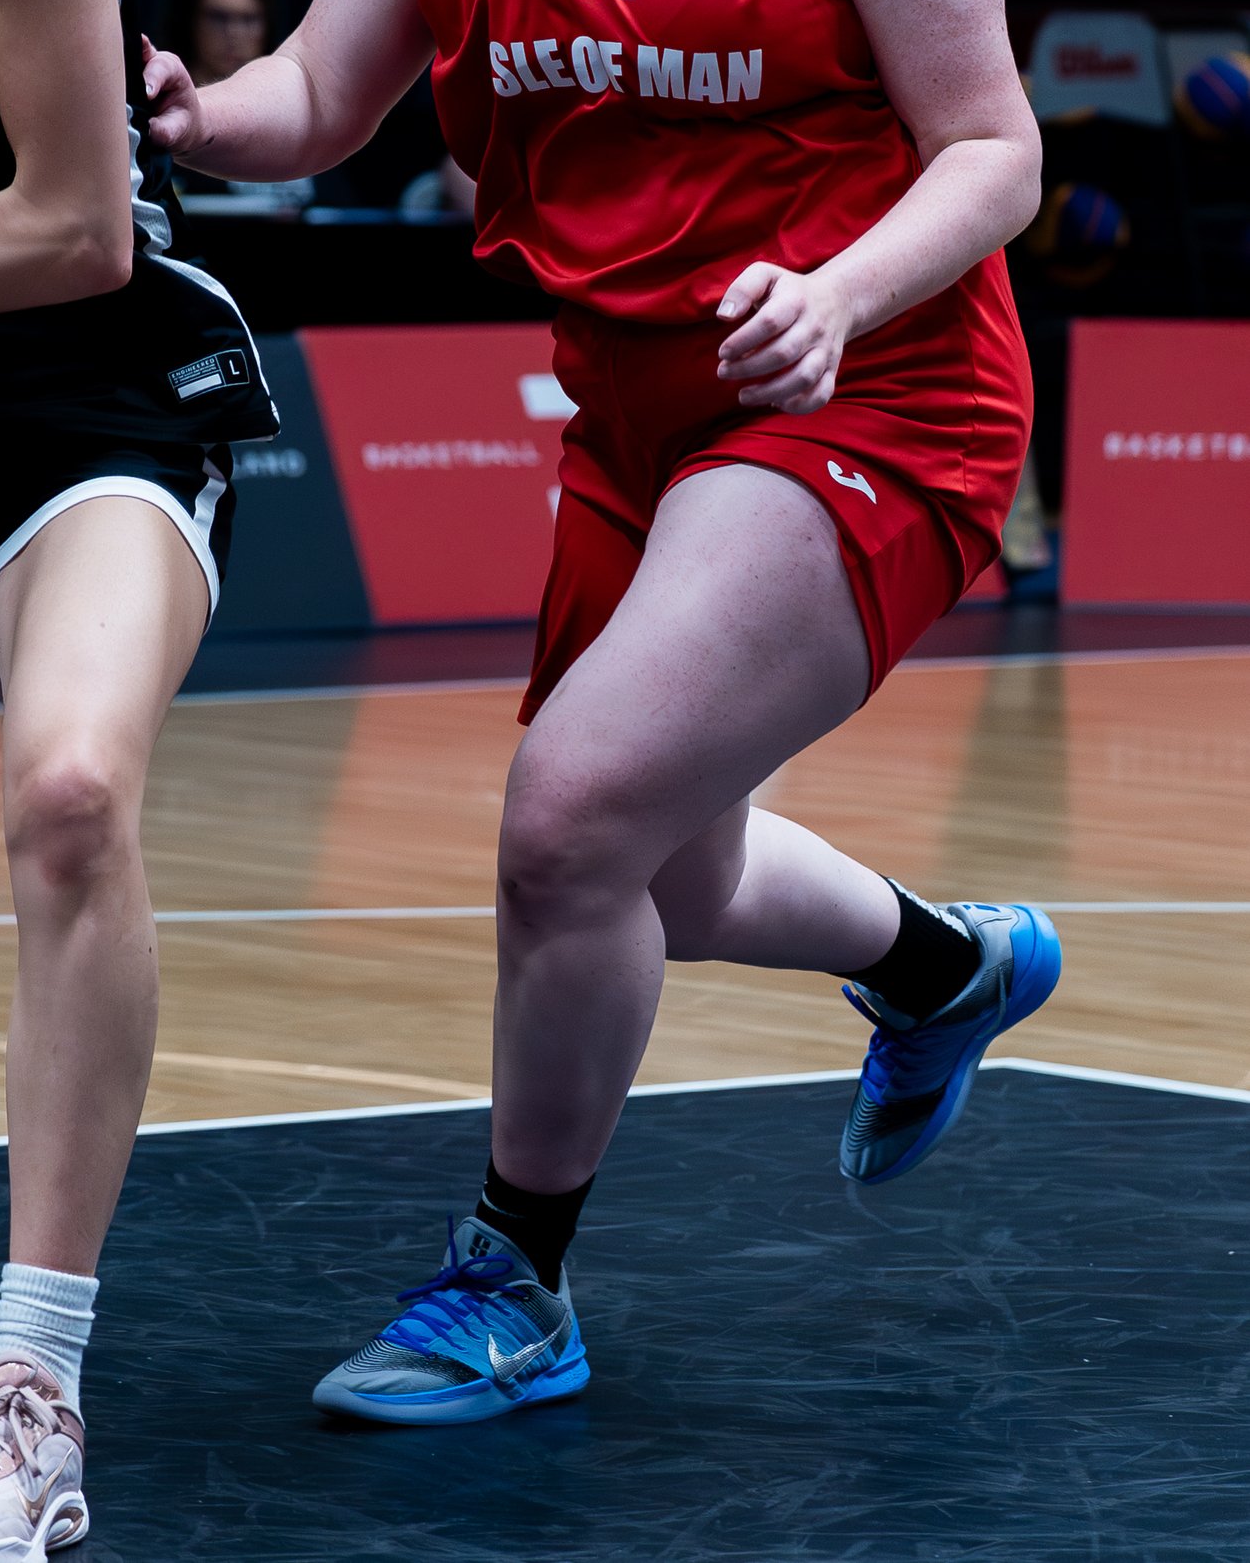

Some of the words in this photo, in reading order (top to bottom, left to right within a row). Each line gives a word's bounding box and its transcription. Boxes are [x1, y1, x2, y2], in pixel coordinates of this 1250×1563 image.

[489, 38, 576, 97] SLE
[637, 44, 763, 104] MAN
[228, 358, 240, 375] L
[1103, 430, 1250, 461] BASKETB
